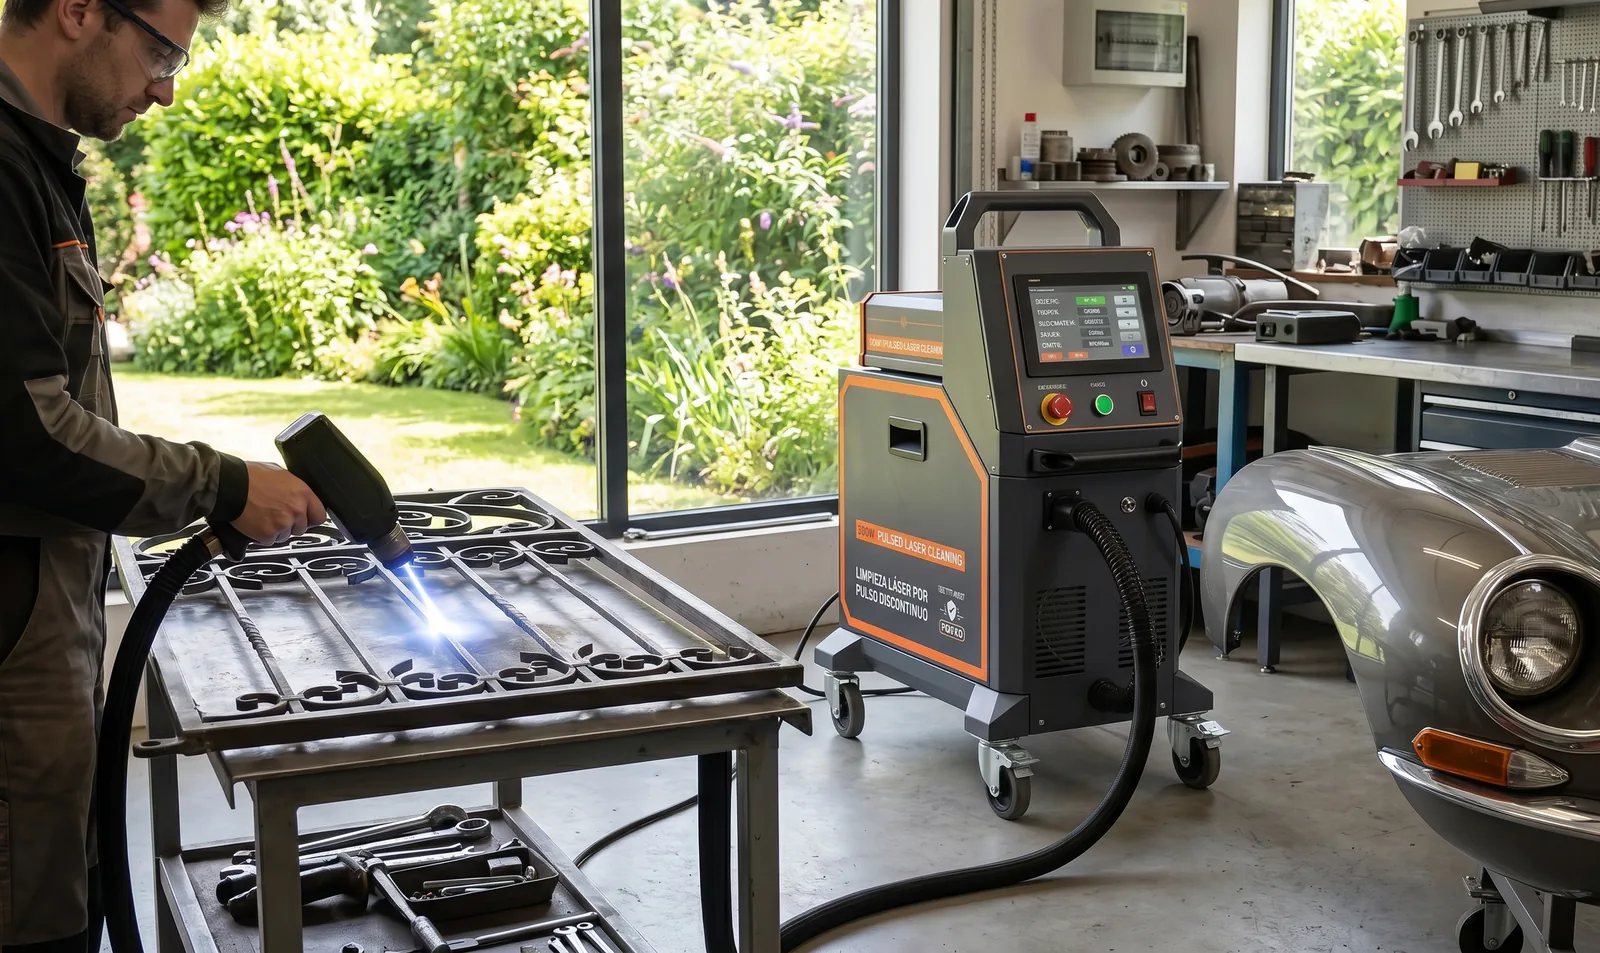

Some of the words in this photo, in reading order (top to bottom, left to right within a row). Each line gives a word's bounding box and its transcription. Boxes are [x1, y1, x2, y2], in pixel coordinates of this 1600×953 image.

[904, 342, 921, 352] LASER
[877, 530, 903, 548] PULSED
[904, 538, 927, 556] LASER
[927, 545, 963, 567] CLEANING
[855, 566, 887, 589] LIMPIEZA
[888, 575, 911, 597] LÁSER
[912, 585, 929, 603] POR
[855, 583, 878, 603] PULSO
[879, 592, 928, 622] DISCONTINUO
